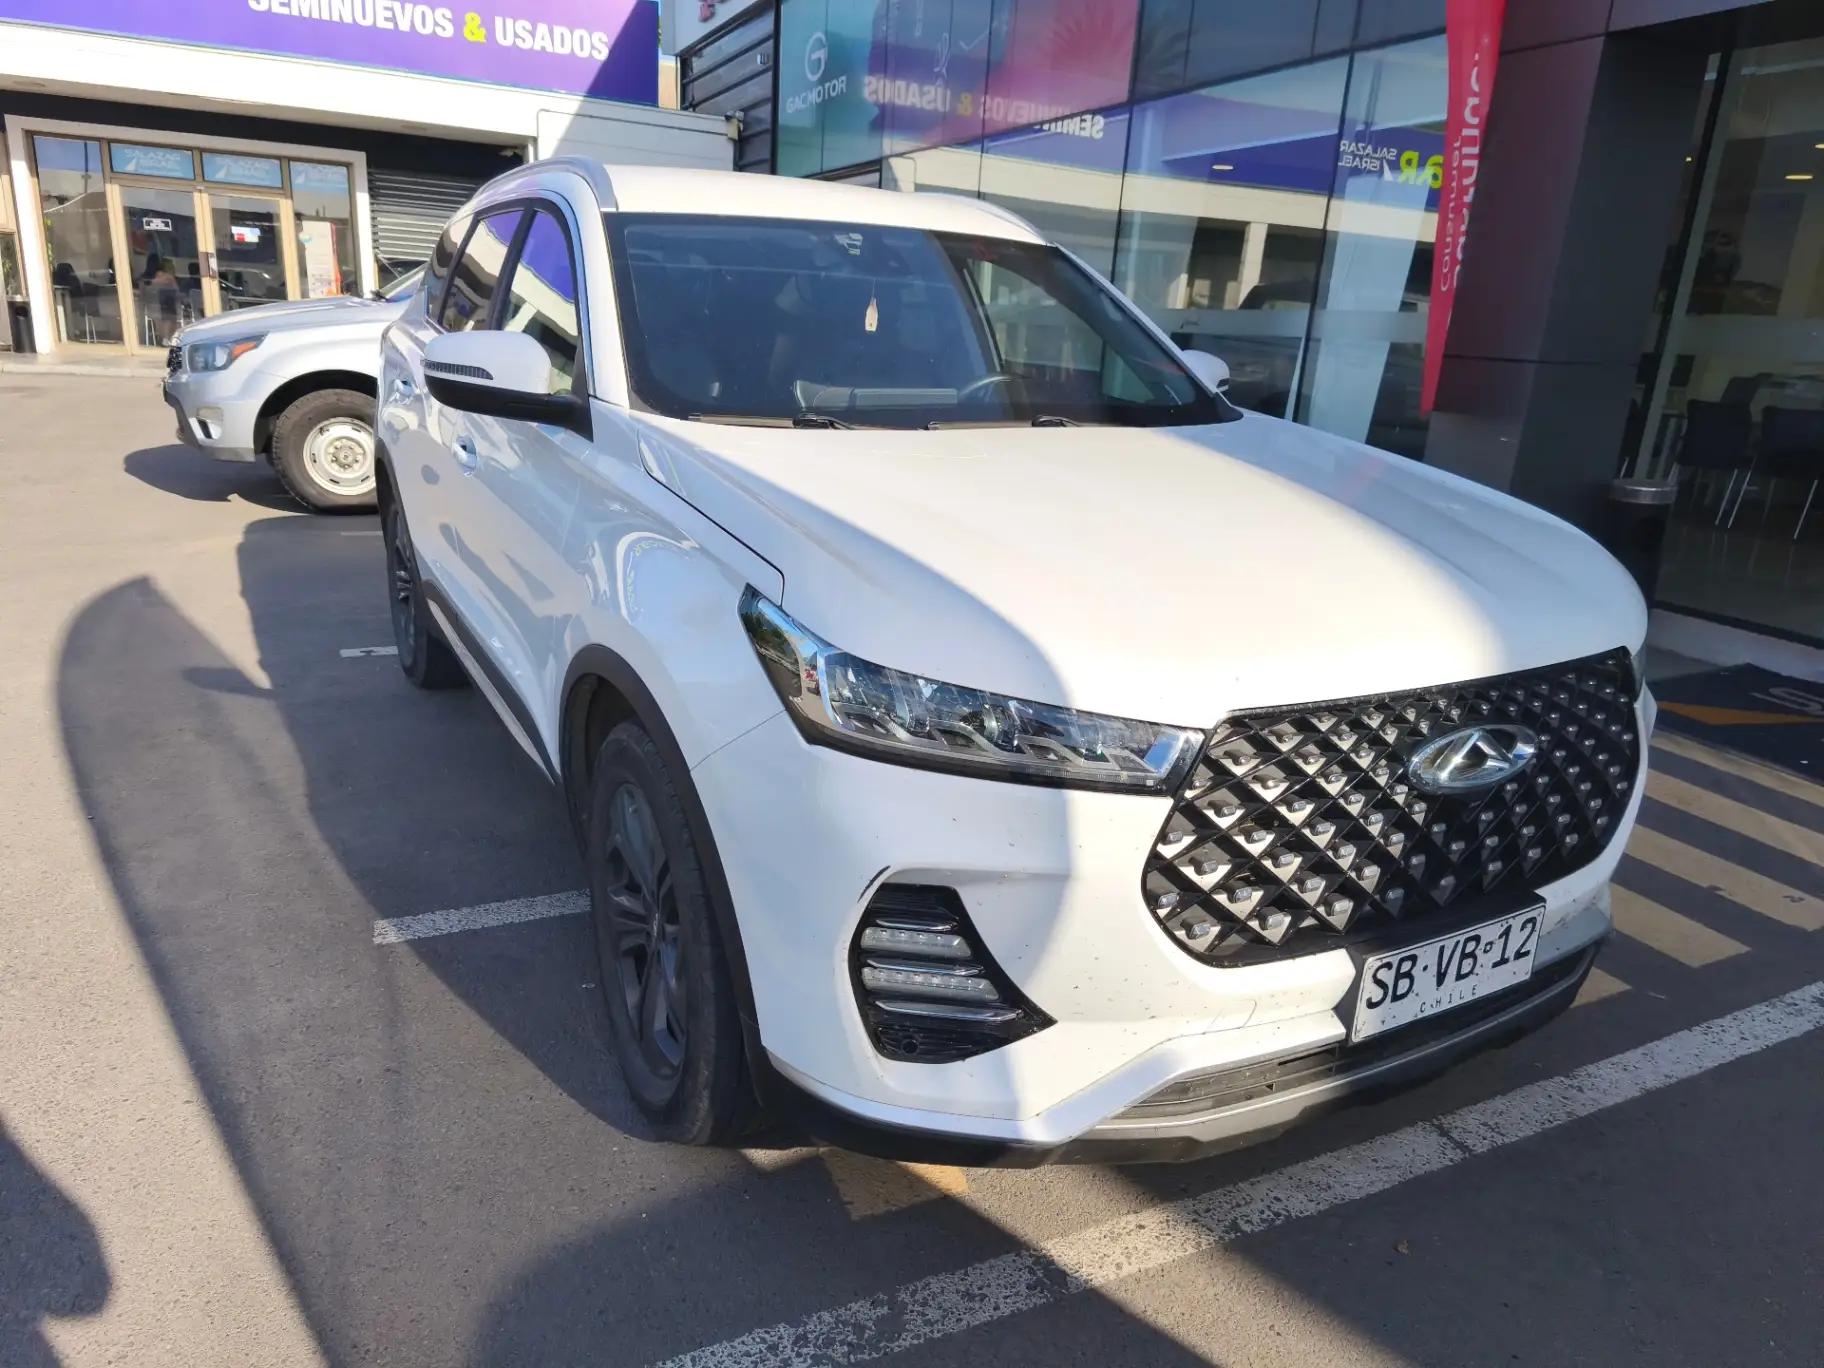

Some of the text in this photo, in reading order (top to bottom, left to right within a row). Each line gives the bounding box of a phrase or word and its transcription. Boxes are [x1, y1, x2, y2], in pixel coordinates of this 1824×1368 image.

[463, 12, 486, 42] &
[494, 15, 609, 61] USADOS
[1419, 983, 1478, 1013] CHILE
